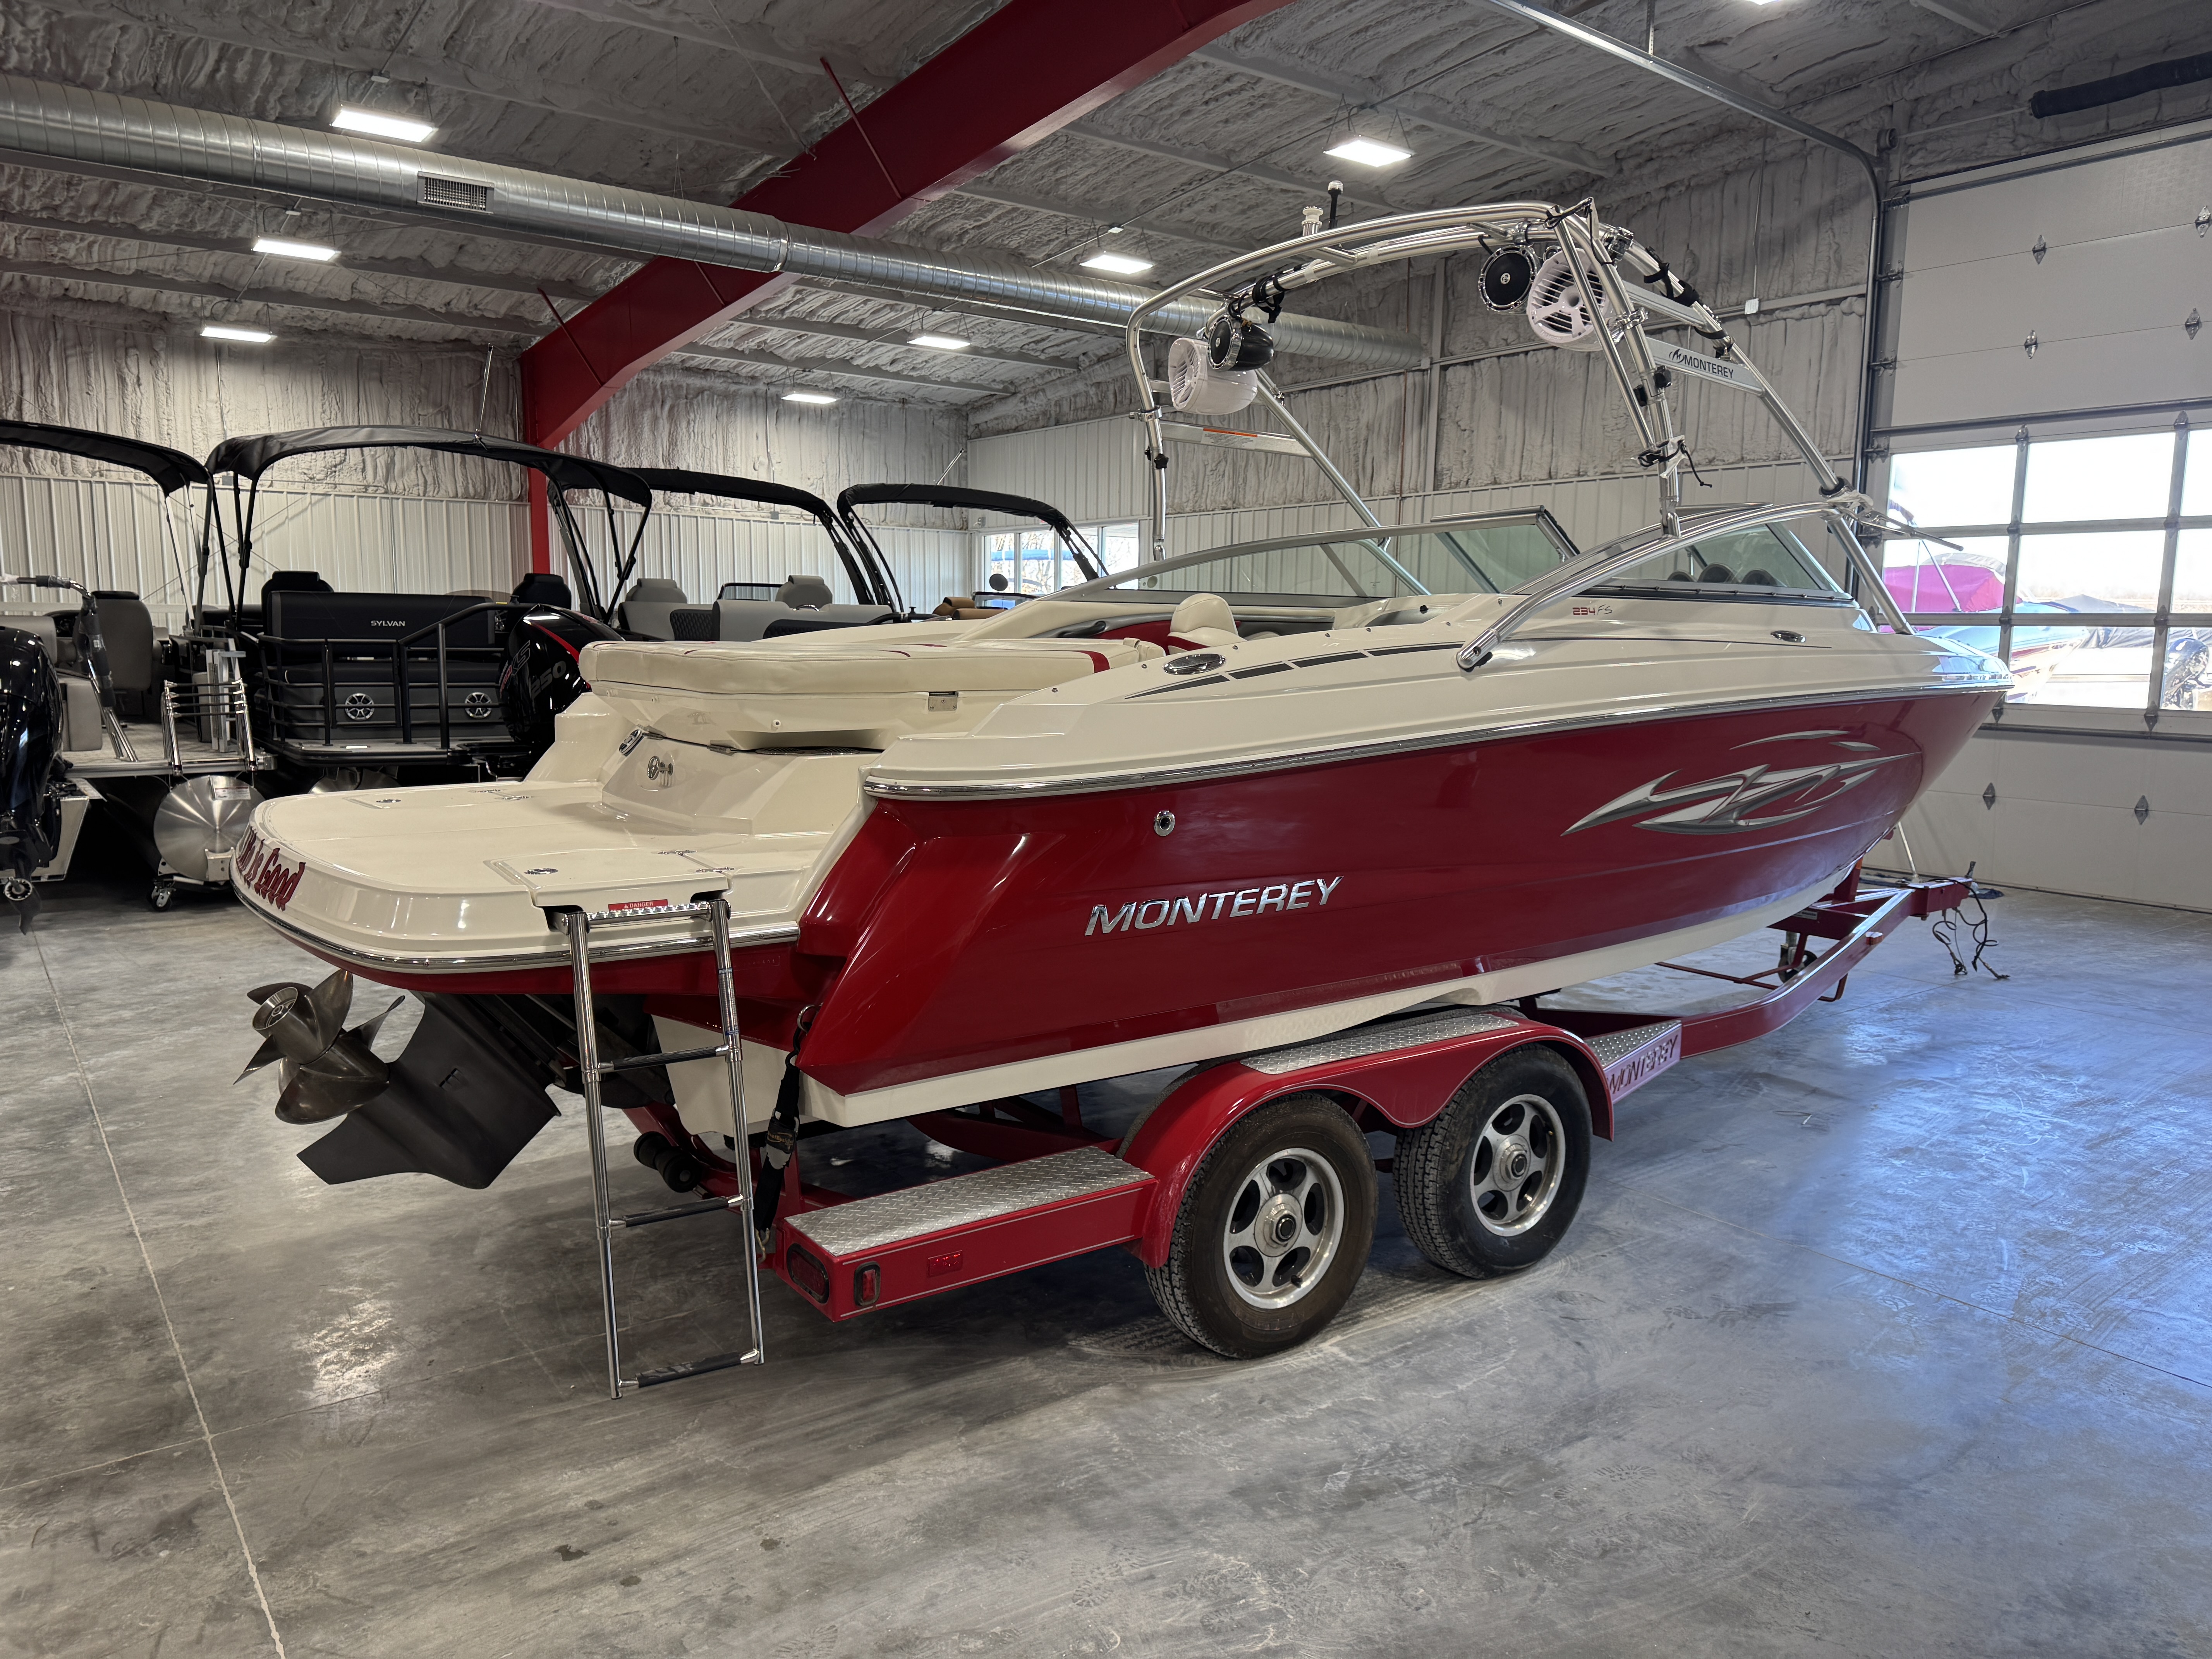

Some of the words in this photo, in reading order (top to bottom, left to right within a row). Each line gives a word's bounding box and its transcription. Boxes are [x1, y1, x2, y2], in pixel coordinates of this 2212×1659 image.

[1685, 354, 1734, 379] MONTEREY
[1572, 607, 1595, 616] 234
[1597, 604, 1613, 615] FS
[531, 660, 567, 700] 250
[254, 847, 306, 912] Good
[1084, 876, 1344, 936] MONTEREY
[1607, 1034, 1678, 1094] MONTEREY
